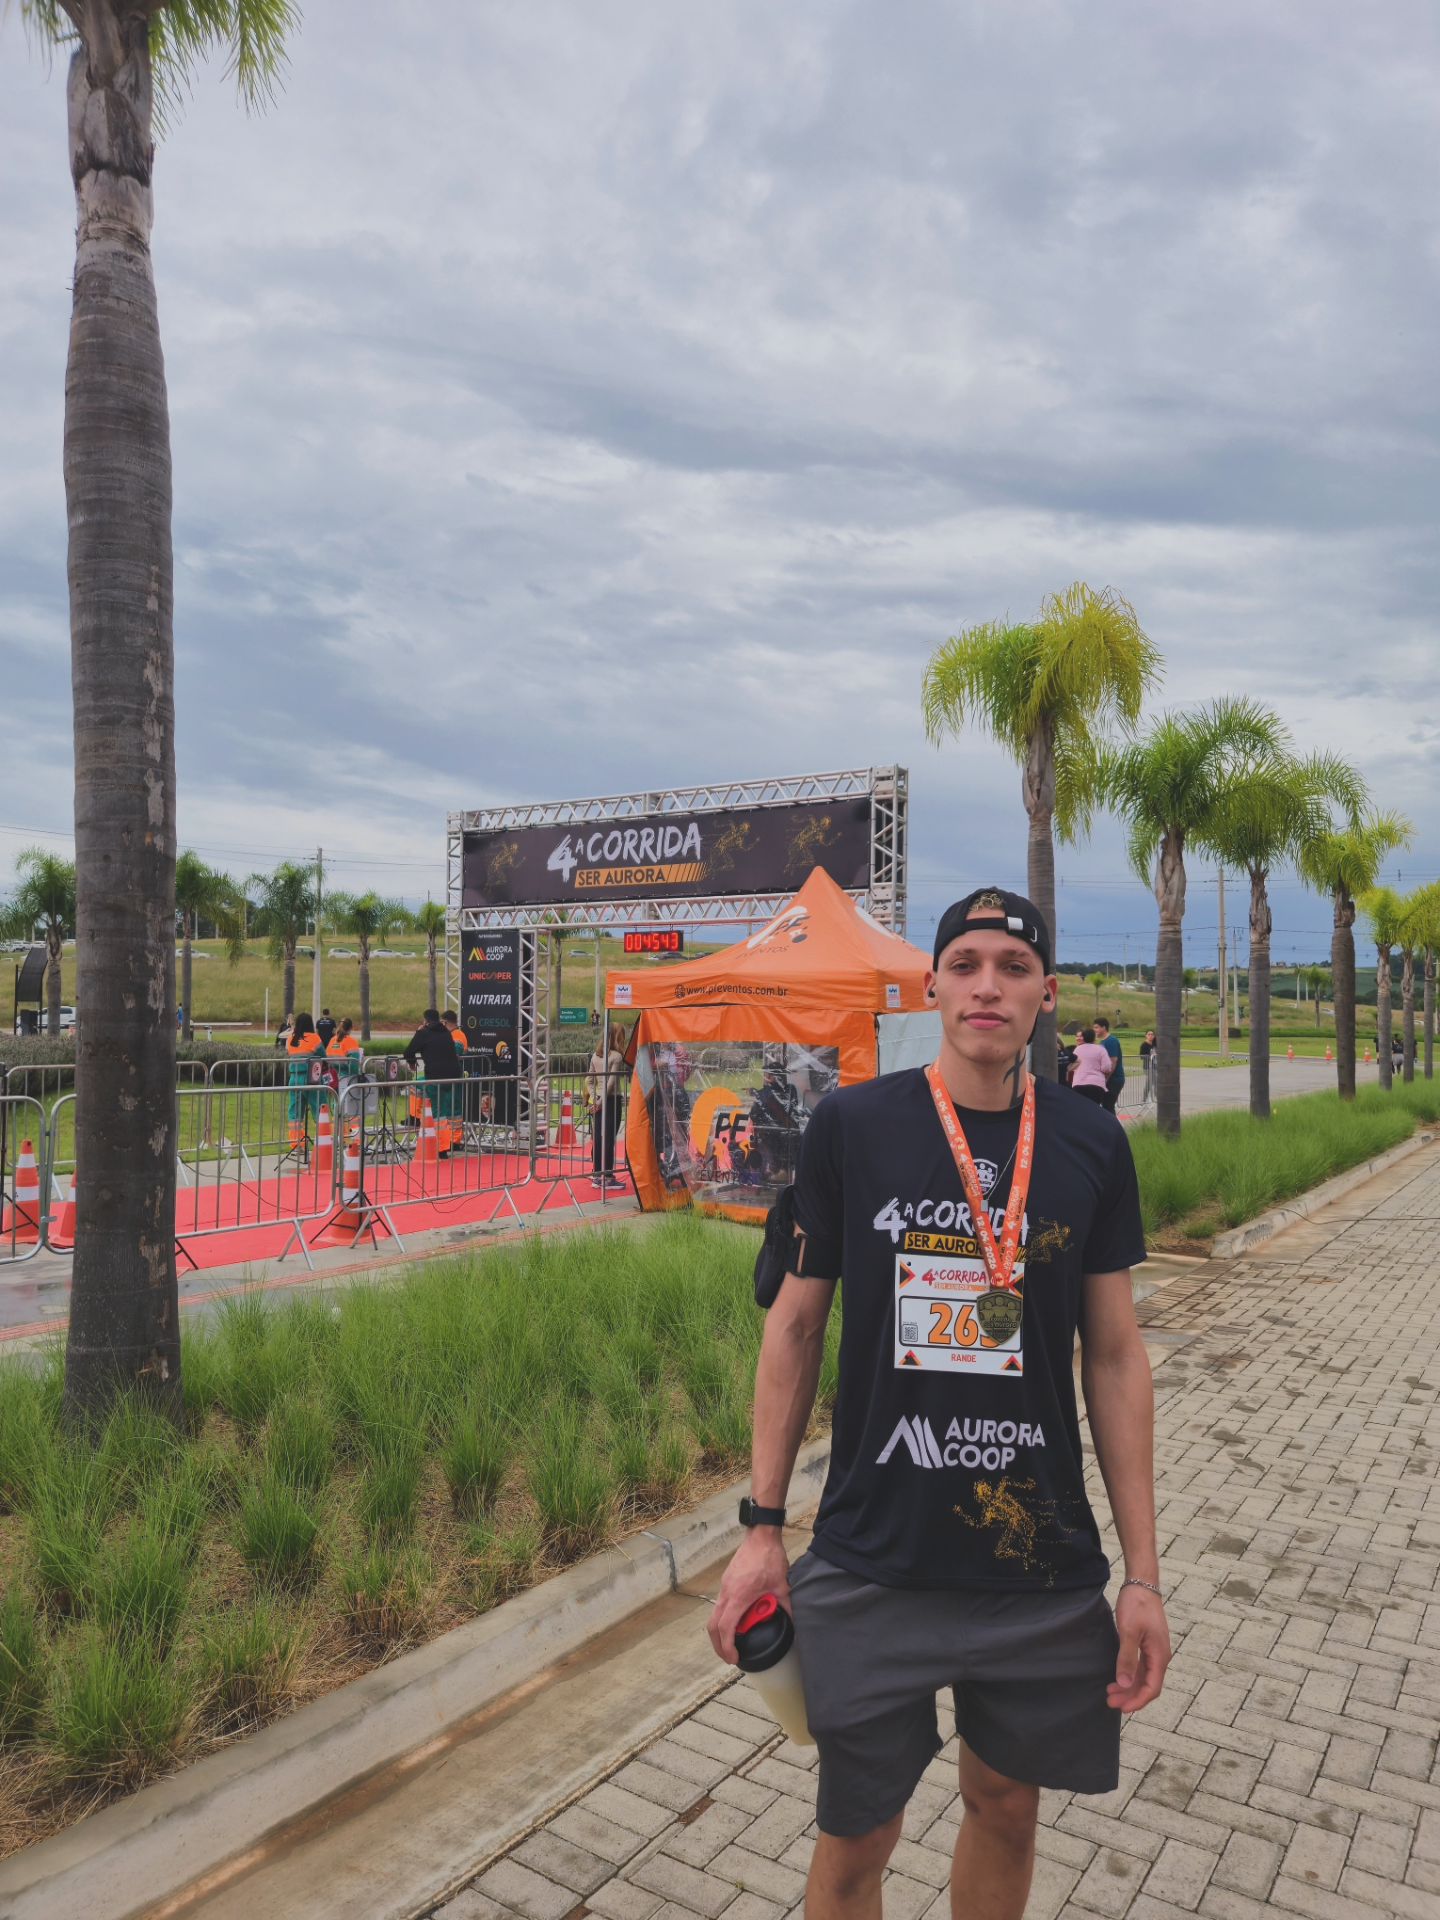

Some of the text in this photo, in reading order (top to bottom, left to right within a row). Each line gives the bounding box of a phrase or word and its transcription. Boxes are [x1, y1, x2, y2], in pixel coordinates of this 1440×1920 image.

[587, 823, 703, 864] CORRIDA
[578, 867, 666, 886] SER AURORA
[486, 945, 513, 953] AURORA
[486, 953, 504, 961] COOP
[468, 994, 512, 1005] NUTRATA
[479, 1017, 511, 1028] CRESOL
[907, 1234, 982, 1255] SER AURO
[940, 1269, 987, 1285] CORRIDA
[945, 1416, 1046, 1447] AURORA
[943, 1443, 1016, 1471] COOP
